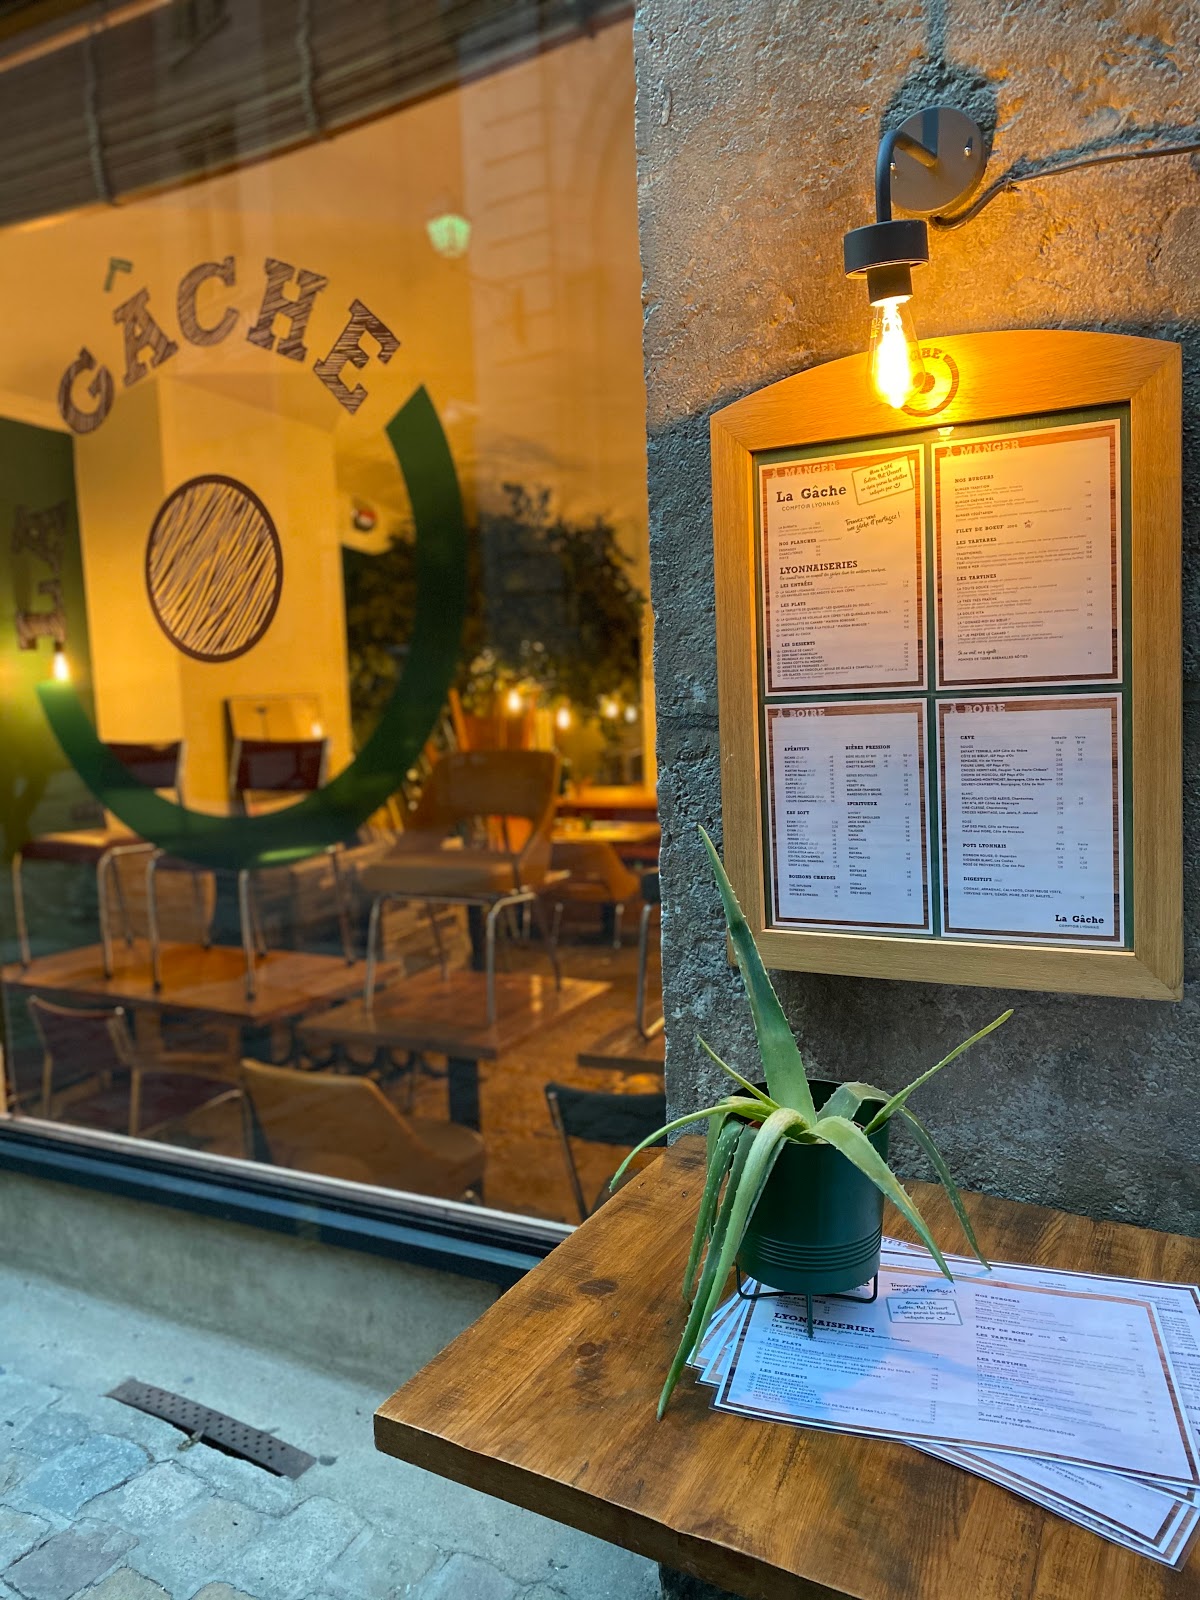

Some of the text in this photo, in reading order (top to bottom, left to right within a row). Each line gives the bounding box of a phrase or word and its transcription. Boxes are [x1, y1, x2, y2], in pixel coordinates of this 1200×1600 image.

[960, 440, 1020, 455] MANGER
[784, 463, 836, 476] MANGER
[776, 491, 793, 503] La
[801, 485, 846, 499] Gâche
[812, 500, 840, 508] LYONNAIS
[780, 561, 858, 574] LYONNAISERIES
[789, 708, 825, 718] BOIRE
[964, 703, 1006, 713] BOIRE
[1072, 915, 1104, 924] Gâche
